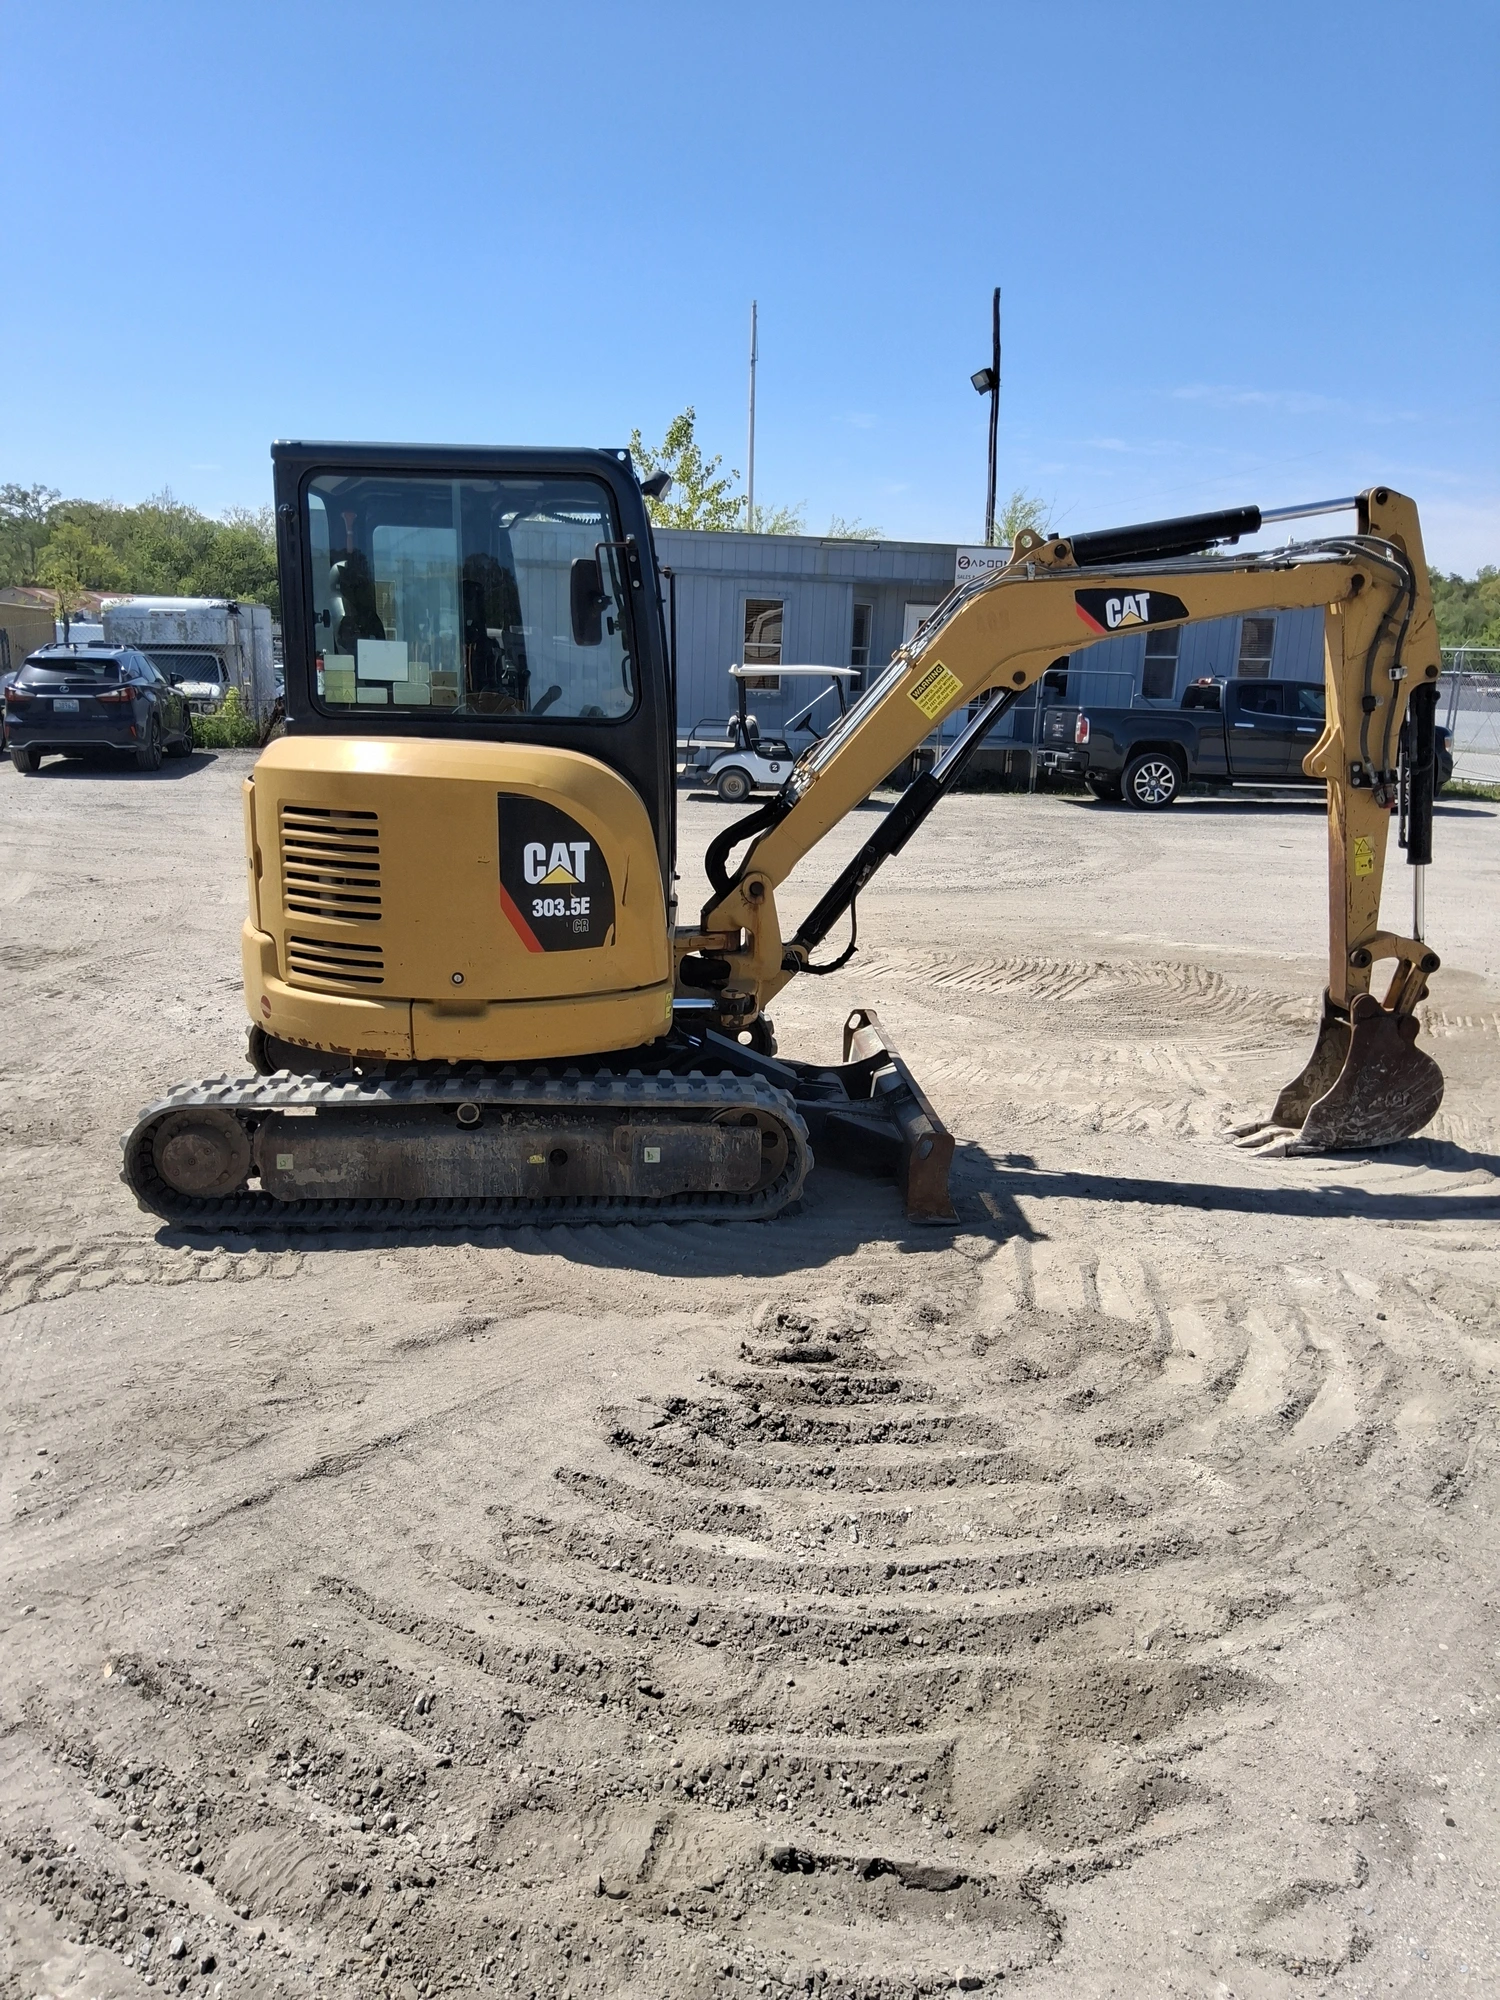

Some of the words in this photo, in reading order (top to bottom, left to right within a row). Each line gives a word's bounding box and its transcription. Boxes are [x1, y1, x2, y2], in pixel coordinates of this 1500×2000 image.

[1106, 592, 1150, 628] CAT
[912, 665, 943, 698] WARNING
[524, 842, 590, 884] CAT
[532, 897, 590, 917] 303.5E
[573, 918, 590, 932] CR
